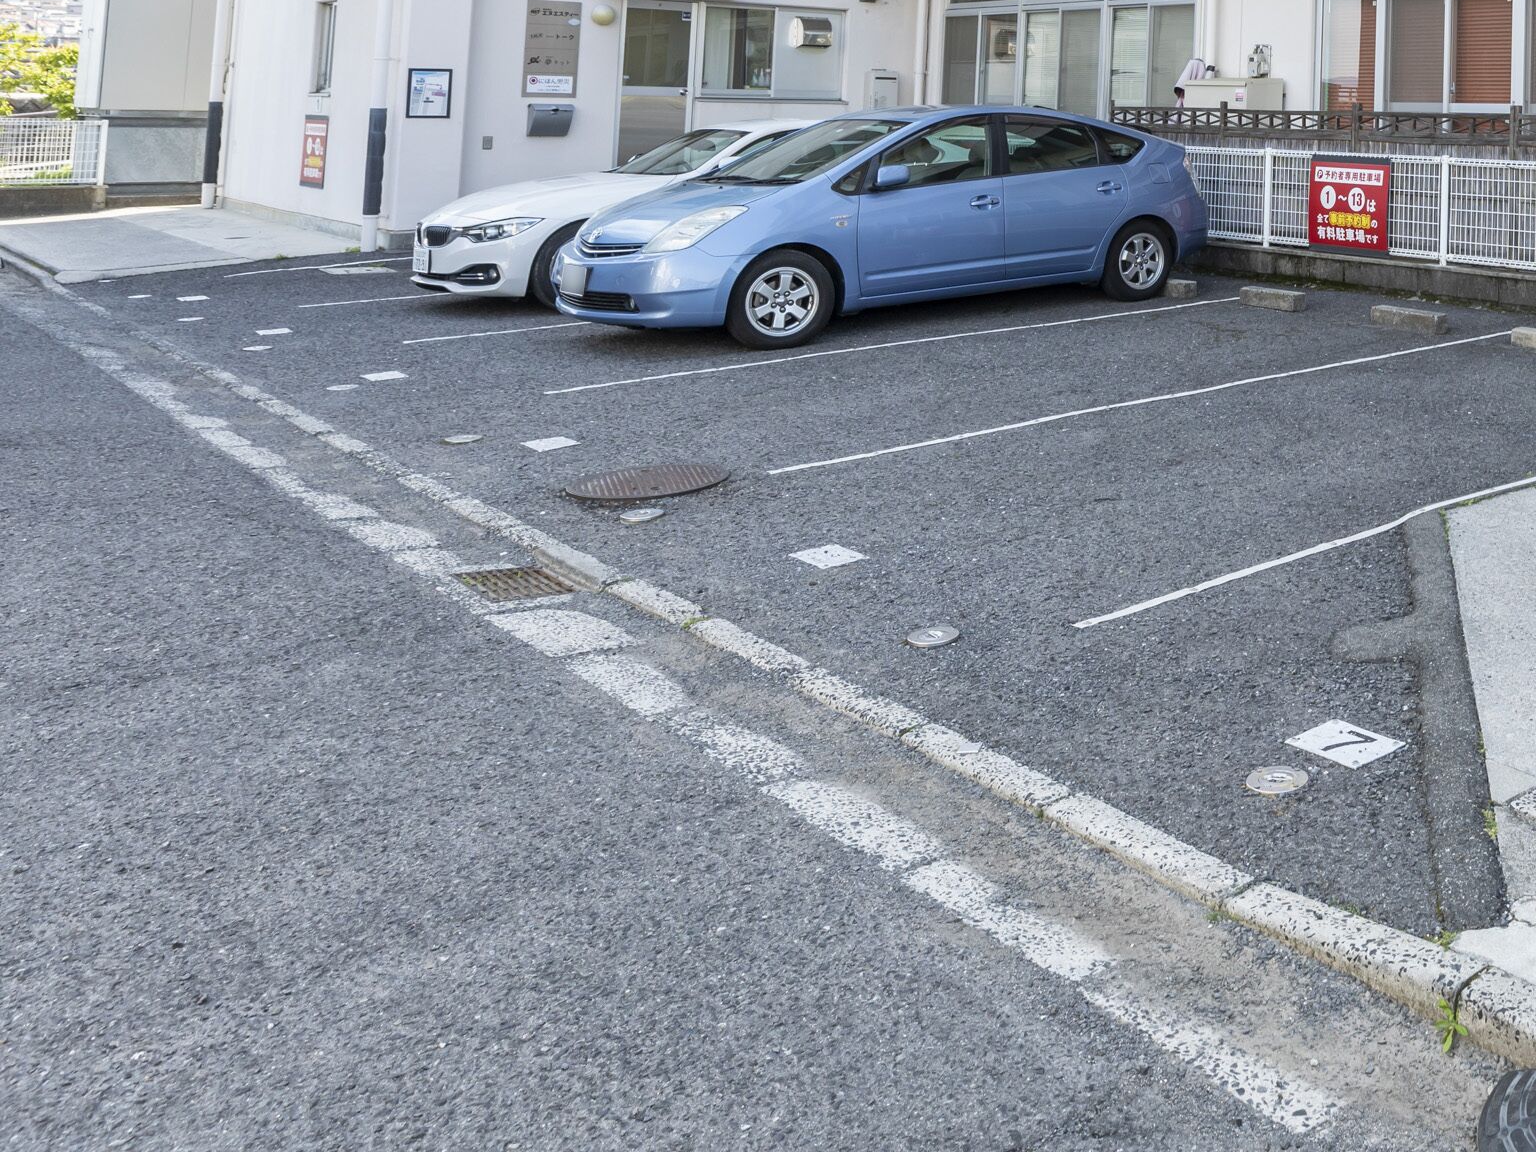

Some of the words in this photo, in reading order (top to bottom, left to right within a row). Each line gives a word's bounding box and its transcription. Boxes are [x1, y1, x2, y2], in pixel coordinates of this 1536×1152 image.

[1325, 170, 1381, 183] 予約者専用駐車場
[1316, 211, 1378, 229] 全て事前予約制の
[1317, 226, 1378, 244] 有料駐車場です
[1320, 730, 1377, 751] 7
